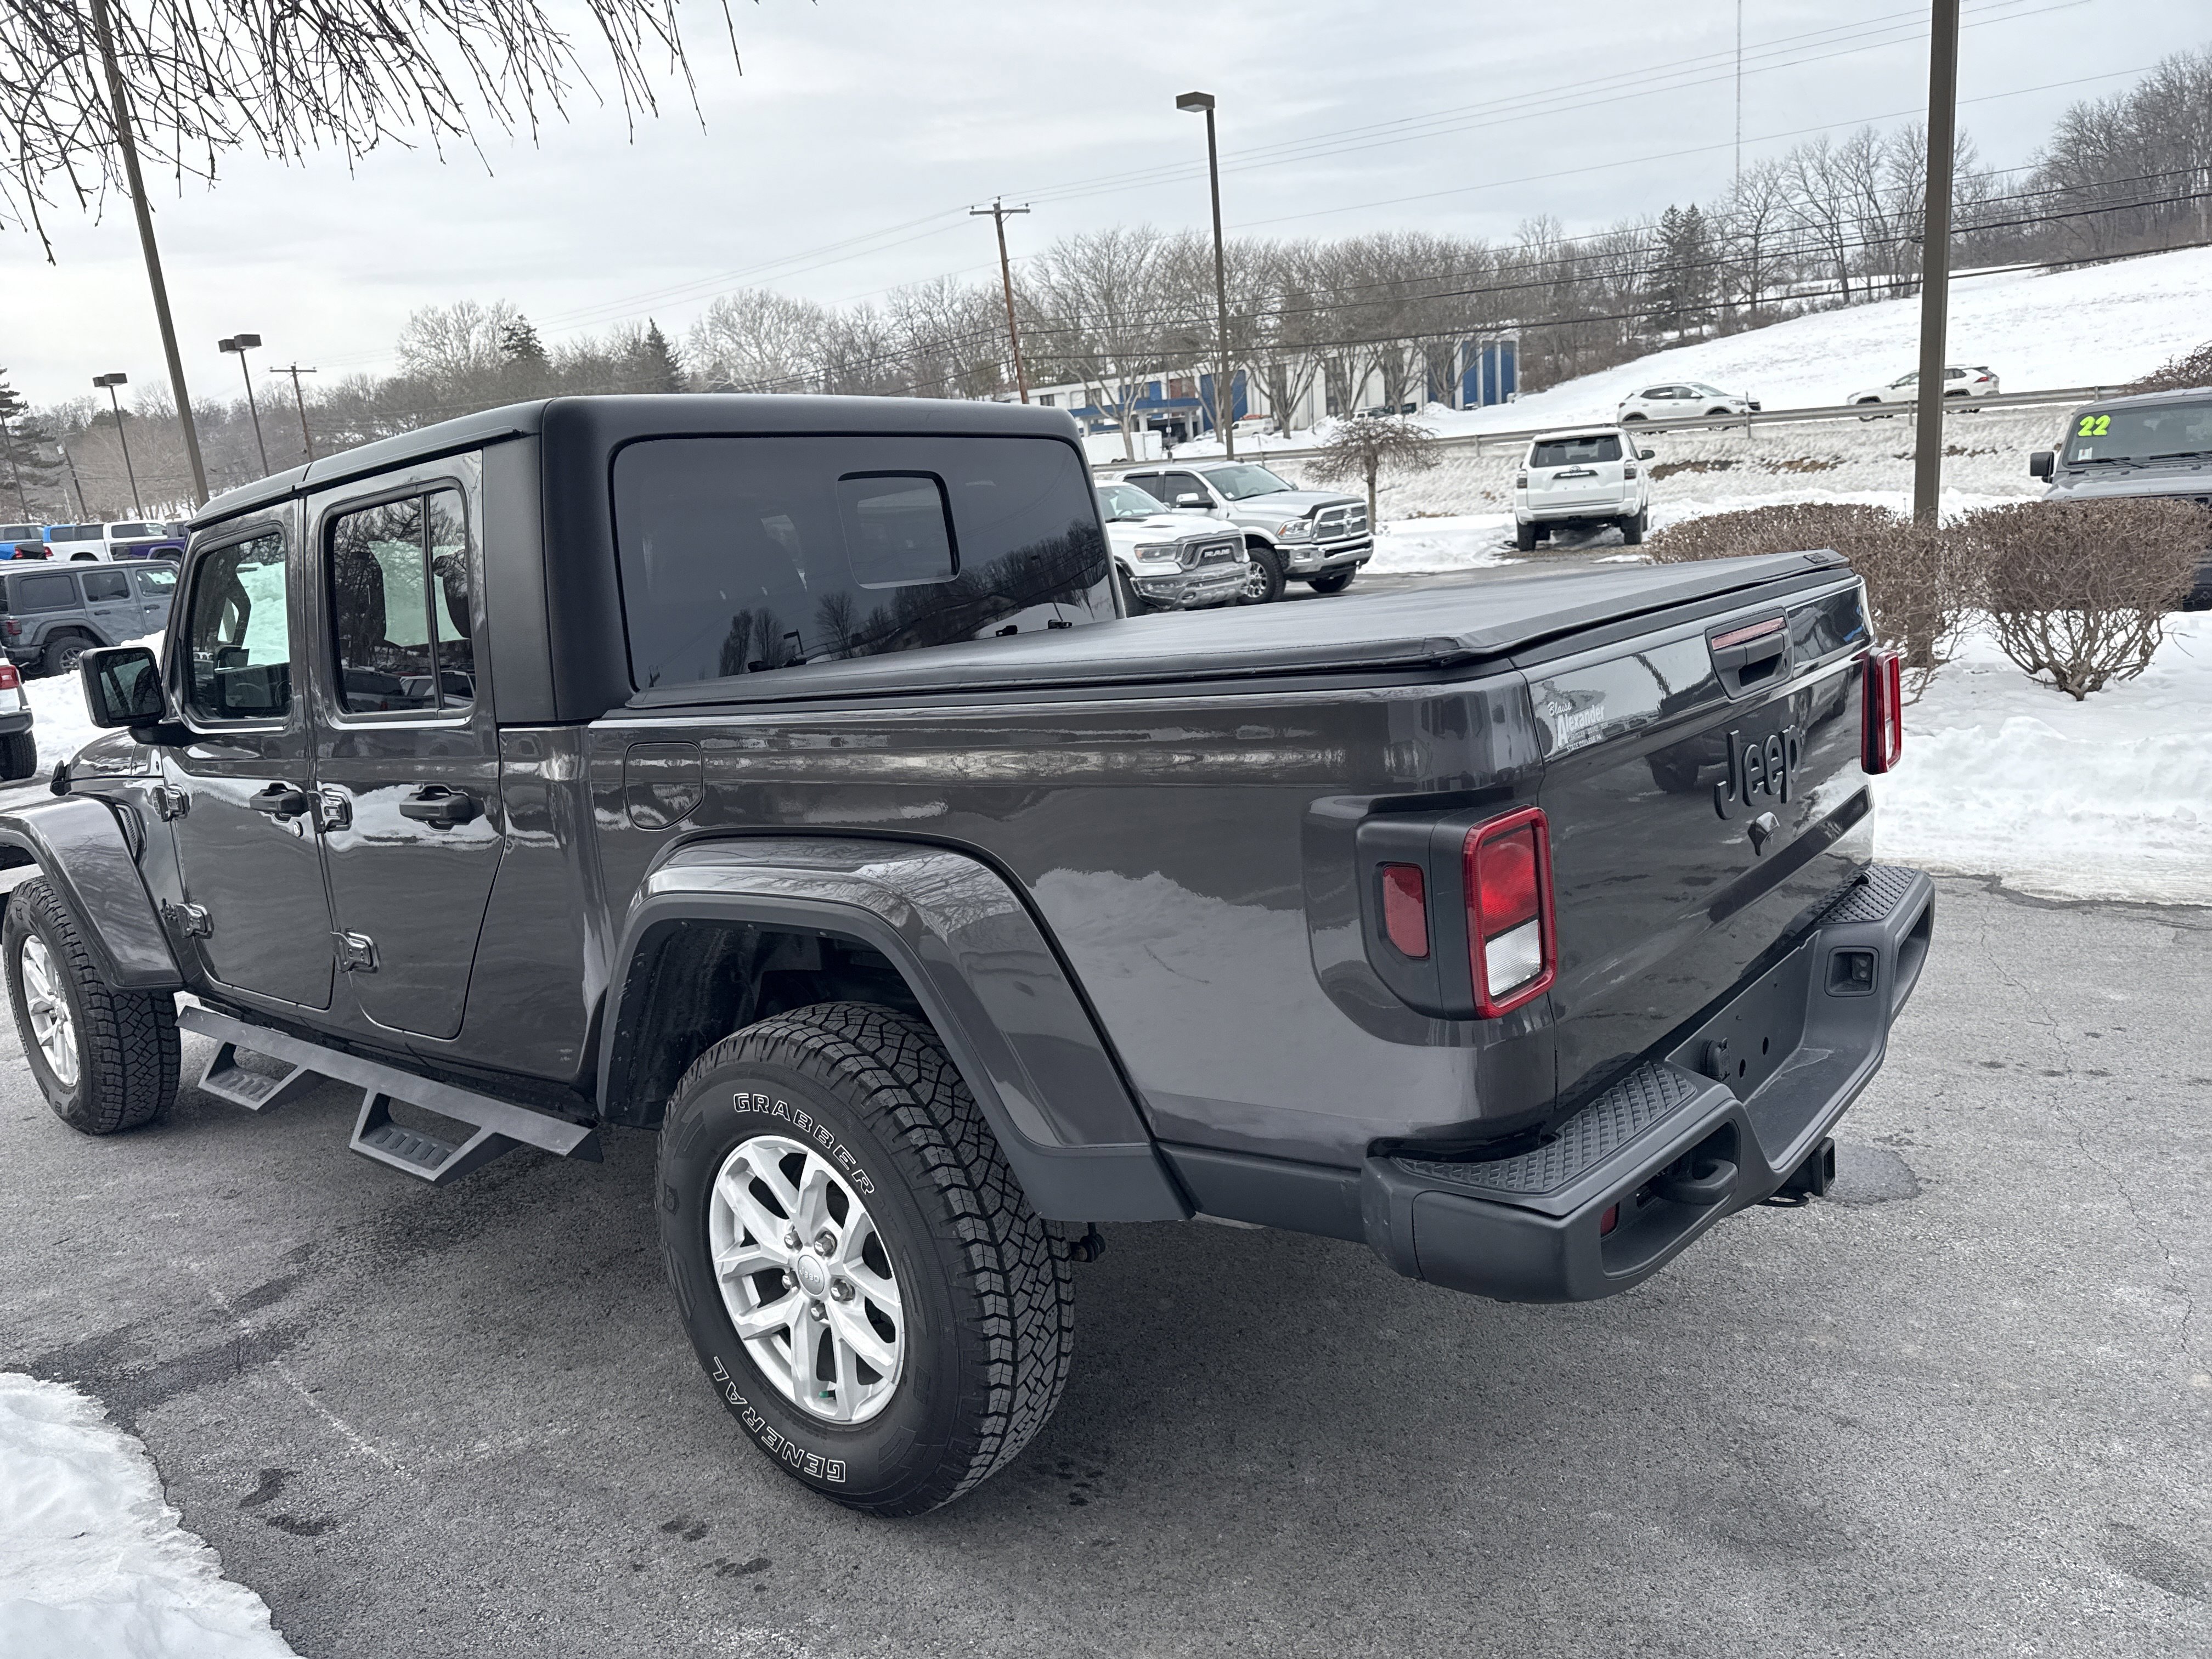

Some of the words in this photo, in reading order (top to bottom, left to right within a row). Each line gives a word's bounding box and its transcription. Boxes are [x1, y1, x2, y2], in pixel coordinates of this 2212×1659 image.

[2078, 415, 2111, 437] 22
[1204, 549, 1230, 558] RAM
[1547, 701, 1573, 716] Blaise
[1558, 704, 1605, 748] Alexander
[1566, 742, 1580, 752] STATE
[1579, 736, 1596, 748] COLLEGE
[1714, 724, 1802, 820] Jeep
[733, 1093, 875, 1196] GRABBER
[799, 1266, 820, 1283] Jeep
[713, 1356, 846, 1483] GENERAL
